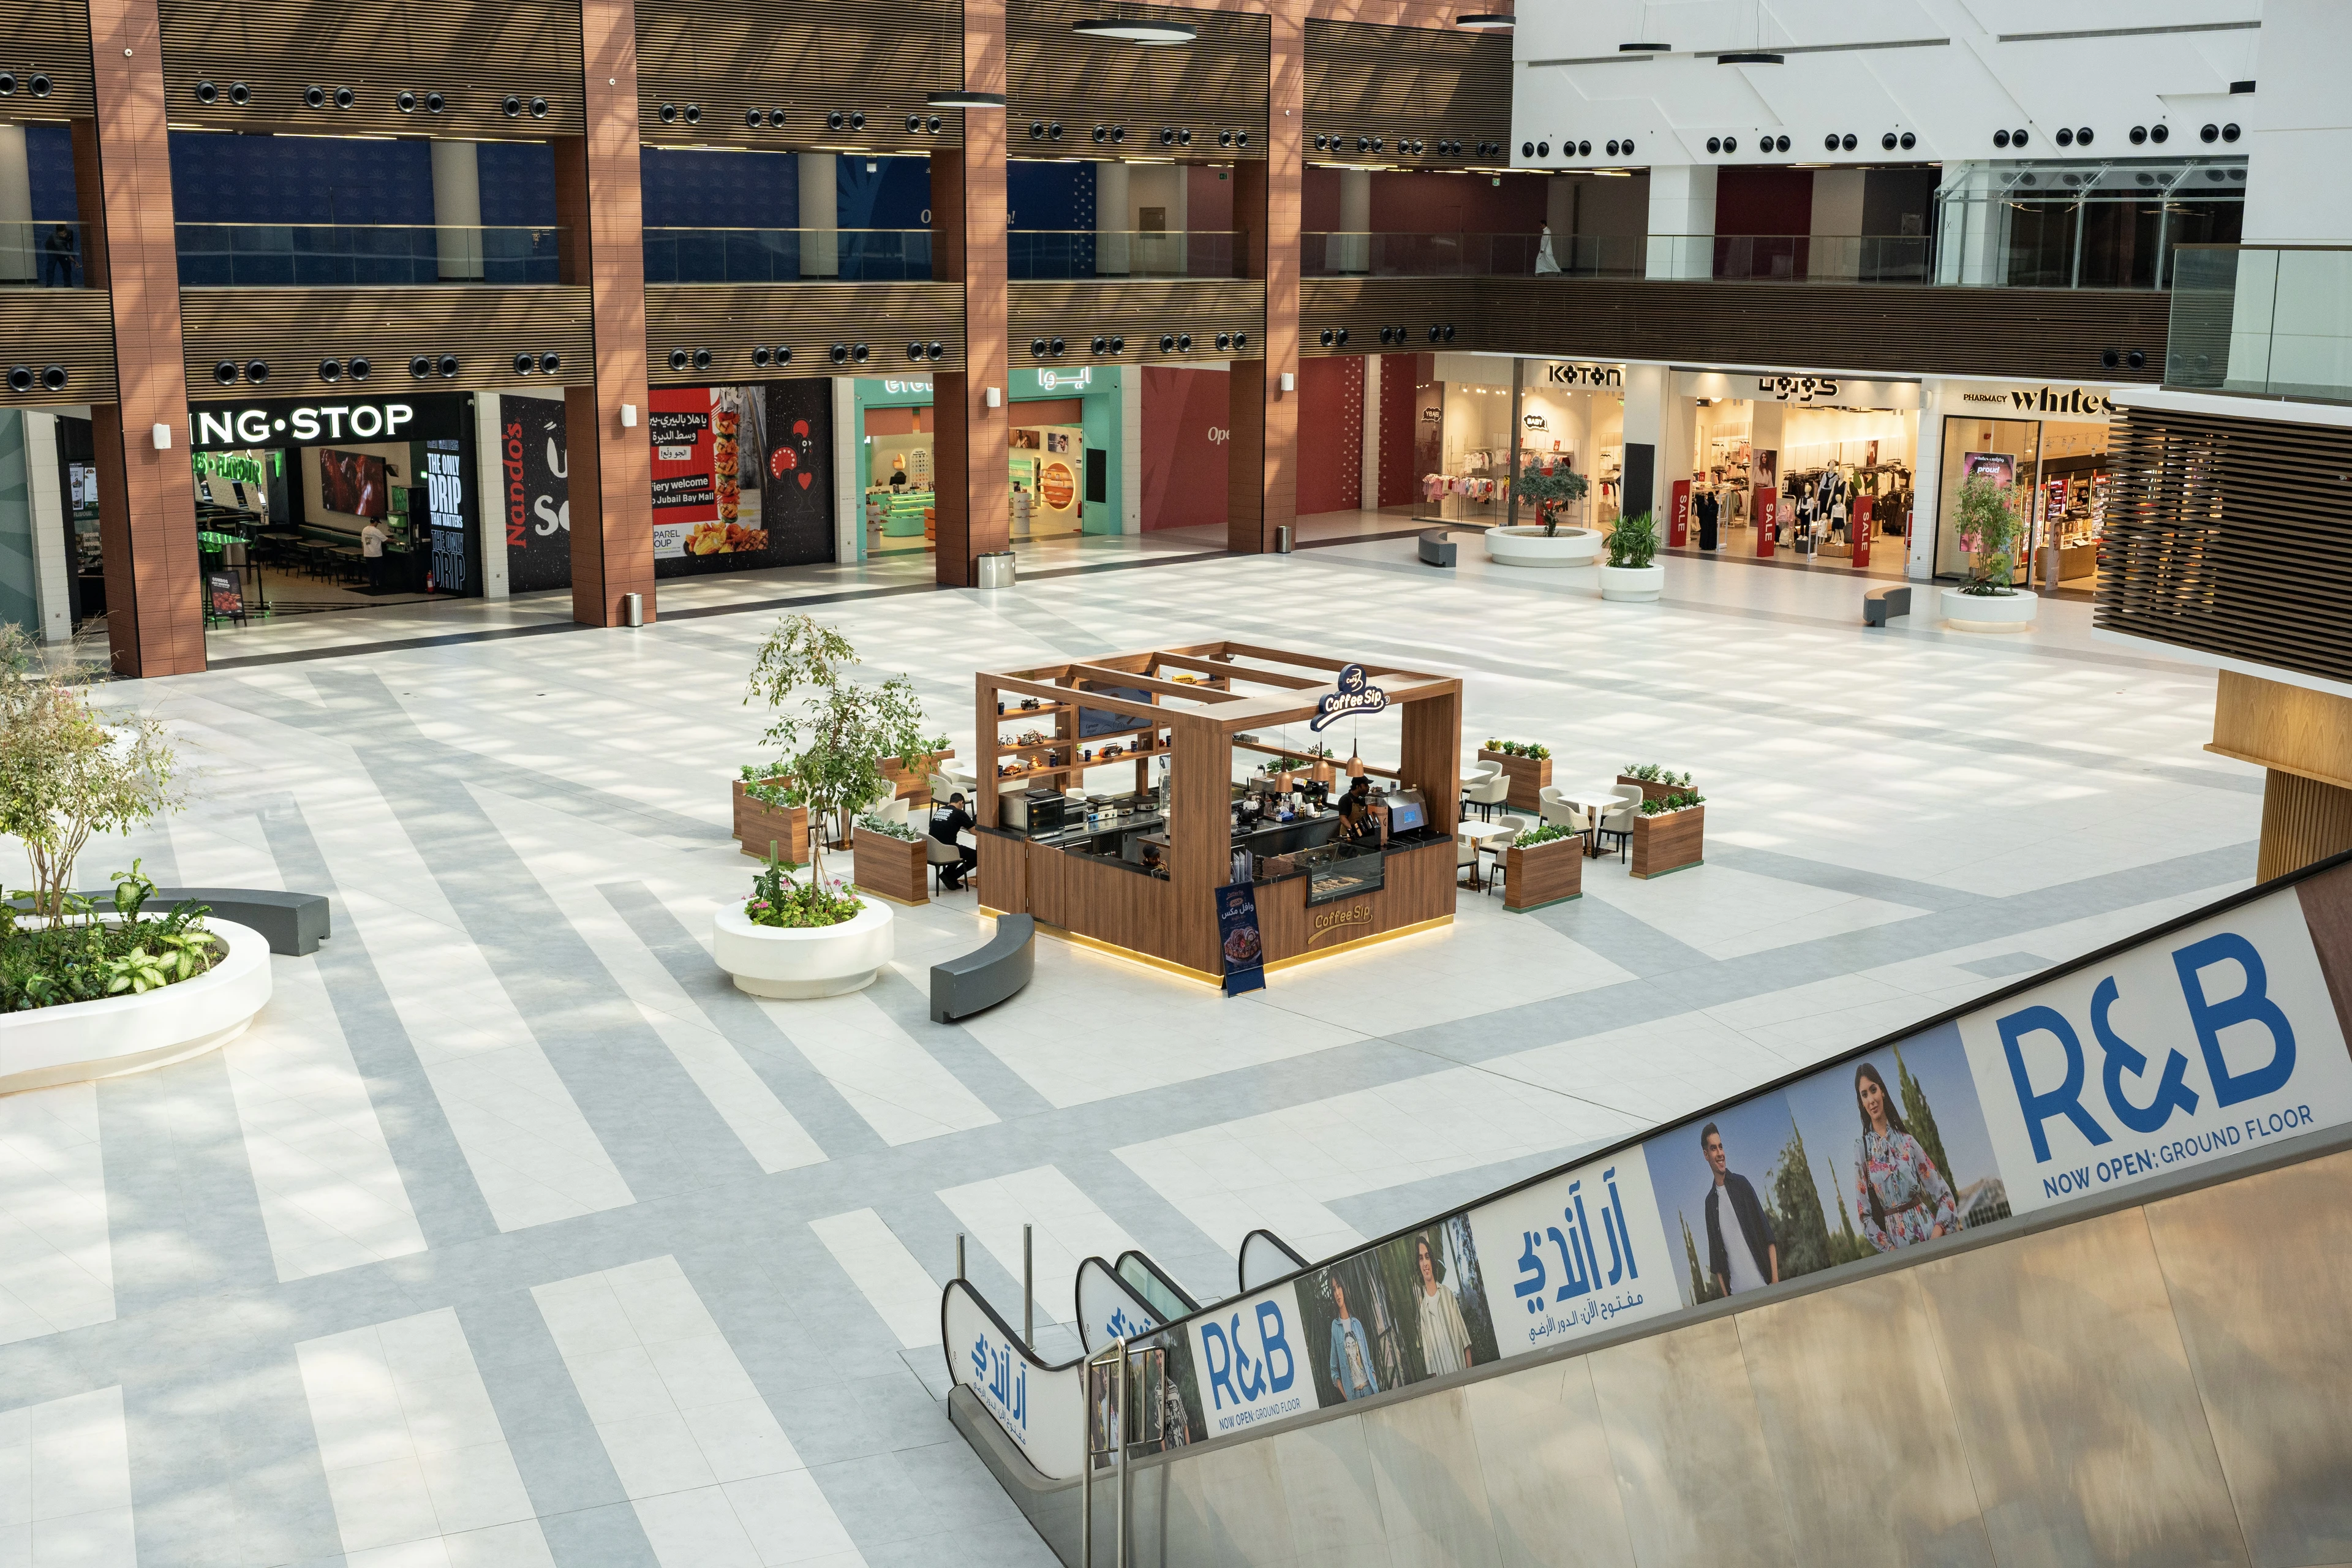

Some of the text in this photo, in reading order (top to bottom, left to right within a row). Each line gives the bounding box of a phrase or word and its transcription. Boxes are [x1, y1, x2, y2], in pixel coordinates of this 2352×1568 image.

[1963, 393, 2008, 402] PHARMACY
[652, 430, 696, 444] وسط الديرة
[427, 453, 460, 477] THE ONLY
[428, 473, 461, 514] DRIP
[502, 422, 527, 548] Nando's
[671, 478, 709, 489] welcome
[657, 494, 681, 504] Jubail
[698, 492, 714, 501] Mall
[430, 511, 463, 529] THAT MATTERS
[1678, 494, 1687, 532] SALE
[1765, 503, 1774, 542] SALE
[431, 530, 464, 554] THE ONLY
[654, 530, 680, 539] PAREL
[654, 539, 672, 548] OUP
[432, 549, 466, 590] DRIP
[1325, 689, 1382, 712] Coffee Sip
[1221, 902, 1254, 919] وافل مكس
[1315, 905, 1370, 928] Coffee Sip
[1996, 932, 2296, 1164] R&B
[2042, 1104, 2314, 1199] NOW OPEN: GROUND FLOOR
[1600, 1291, 1643, 1320] مفتوح
[1558, 1310, 1579, 1333] الدور
[1200, 1300, 1295, 1411] R&B
[1218, 1397, 1301, 1431] NOW OPEN: GROUND FLOOR
[1006, 1419, 1026, 1446] مفتوح
